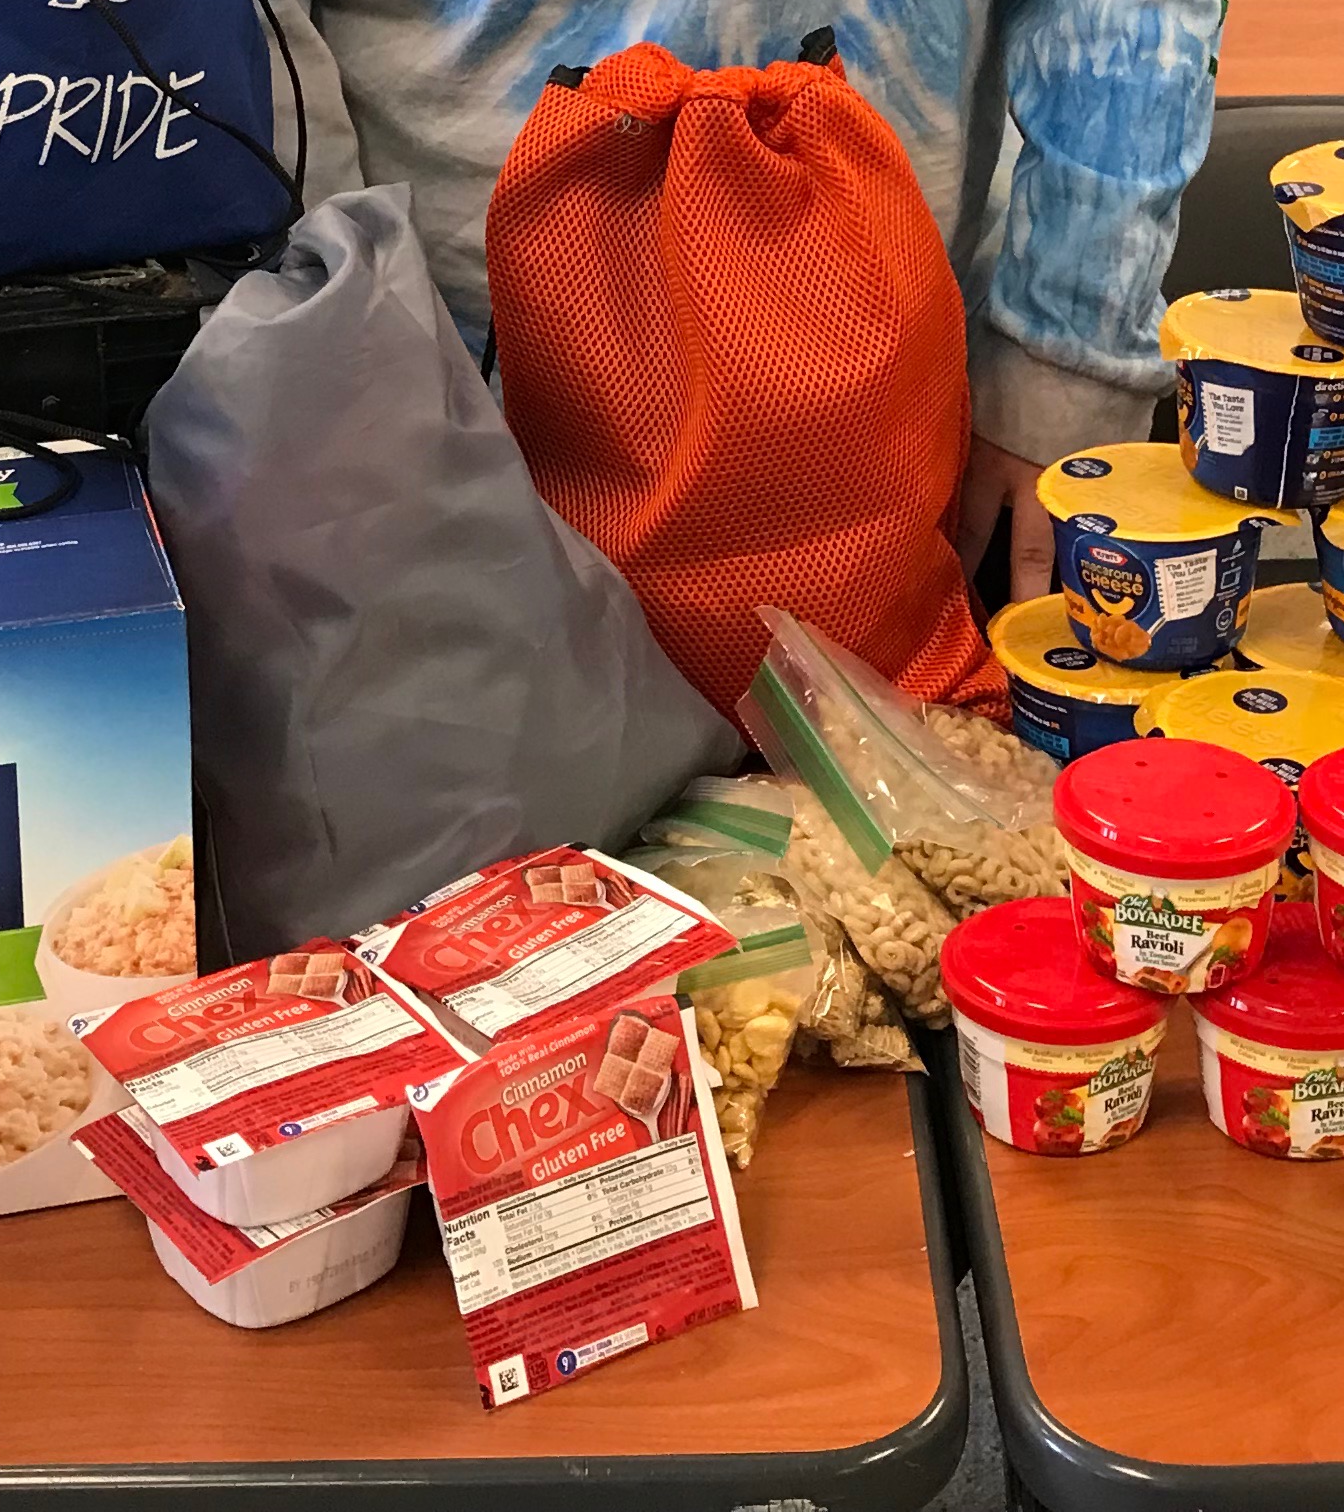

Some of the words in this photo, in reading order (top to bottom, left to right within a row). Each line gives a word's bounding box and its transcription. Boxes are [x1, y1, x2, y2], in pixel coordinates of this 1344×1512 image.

[1080, 559, 1133, 581] macaroni
[1121, 895, 1148, 909] Chef
[1114, 904, 1204, 934] BOYARDEE
[507, 925, 557, 960] Gluten
[550, 909, 585, 932] Free
[1130, 934, 1185, 956] Ravioli
[1146, 930, 1170, 941] Beef
[167, 977, 254, 1019] Cinnamon
[129, 988, 281, 1052] Chex
[215, 1013, 276, 1042] Gluten
[273, 1002, 313, 1022] Free
[498, 1058, 527, 1078] 100%
[527, 1046, 548, 1064] Real
[549, 1022, 596, 1051] Cinnamon
[124, 1065, 179, 1090] Nutrition
[131, 1078, 165, 1095] Facts
[501, 1052, 588, 1107] Cinnamon
[460, 1071, 601, 1175] Chex
[531, 1142, 589, 1182] Gluten
[589, 1122, 627, 1152] Free
[619, 1167, 664, 1190] Carbohydrate
[443, 1208, 491, 1235] Nutrition
[446, 1228, 476, 1248] Facts
